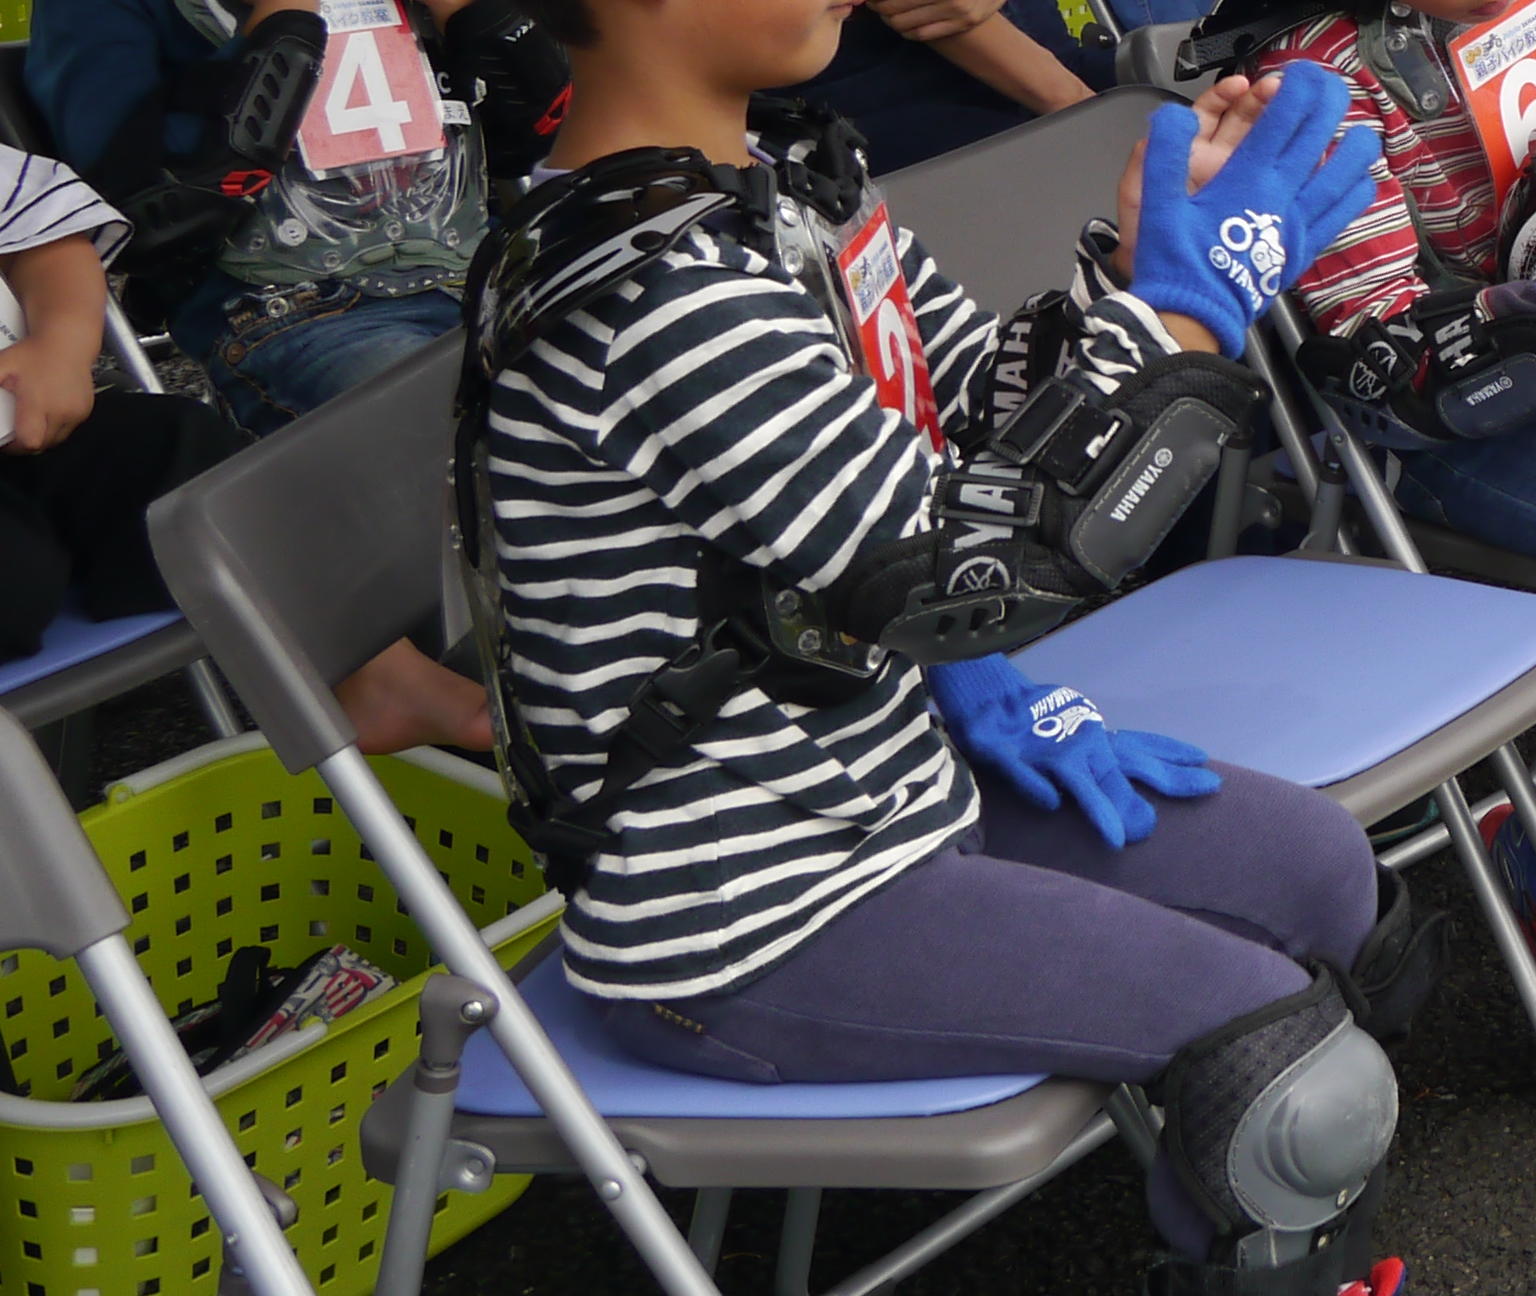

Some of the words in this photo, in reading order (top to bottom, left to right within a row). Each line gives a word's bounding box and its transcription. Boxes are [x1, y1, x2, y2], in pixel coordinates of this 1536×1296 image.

[325, 31, 413, 153] 4
[1466, 382, 1503, 406] YAMAHA
[1110, 464, 1165, 523] YAMAHA
